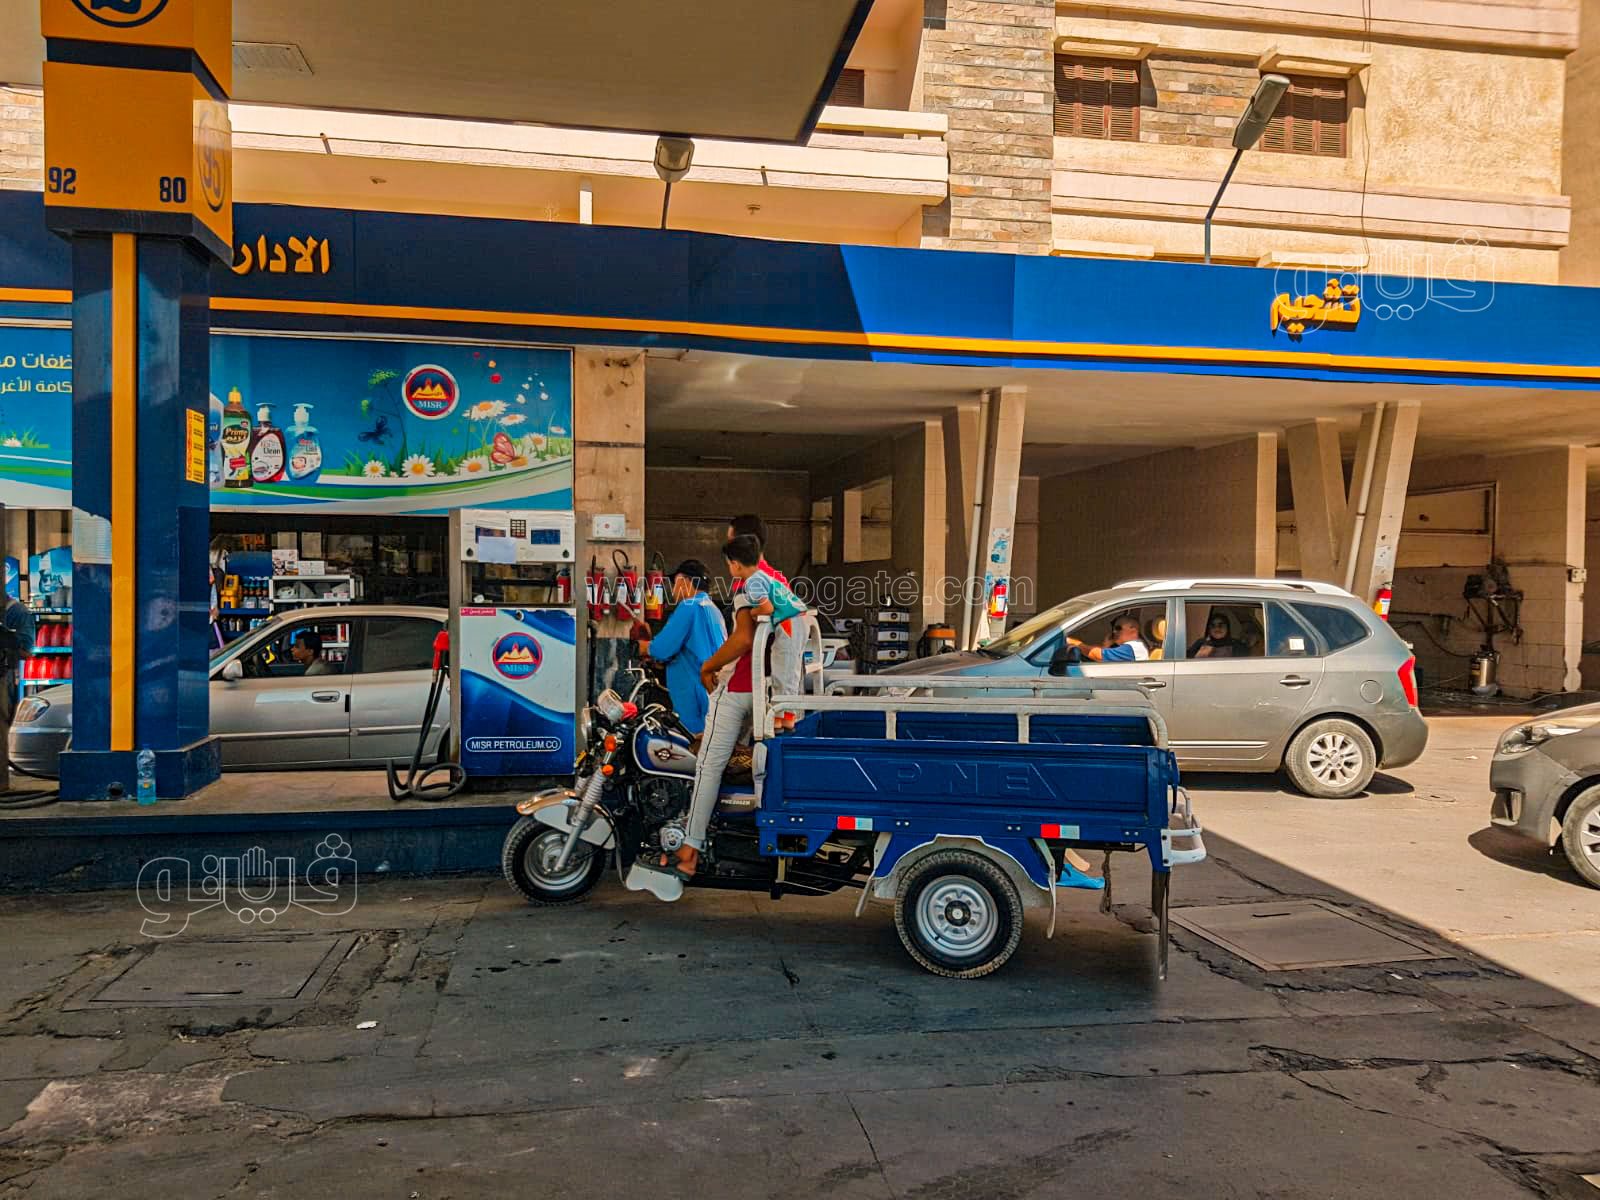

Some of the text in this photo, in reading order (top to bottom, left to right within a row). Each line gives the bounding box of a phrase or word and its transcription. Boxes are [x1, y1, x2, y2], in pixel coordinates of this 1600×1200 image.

[48, 166, 77, 195] 92
[159, 177, 187, 203] 80
[231, 234, 331, 275] الادار
[1270, 278, 1361, 334] تشحيم
[22, 353, 73, 370] ظفات
[0, 376, 31, 395] الأغر
[418, 400, 443, 409] MISR
[503, 663, 530, 672] MISR
[471, 740, 493, 750] MISR
